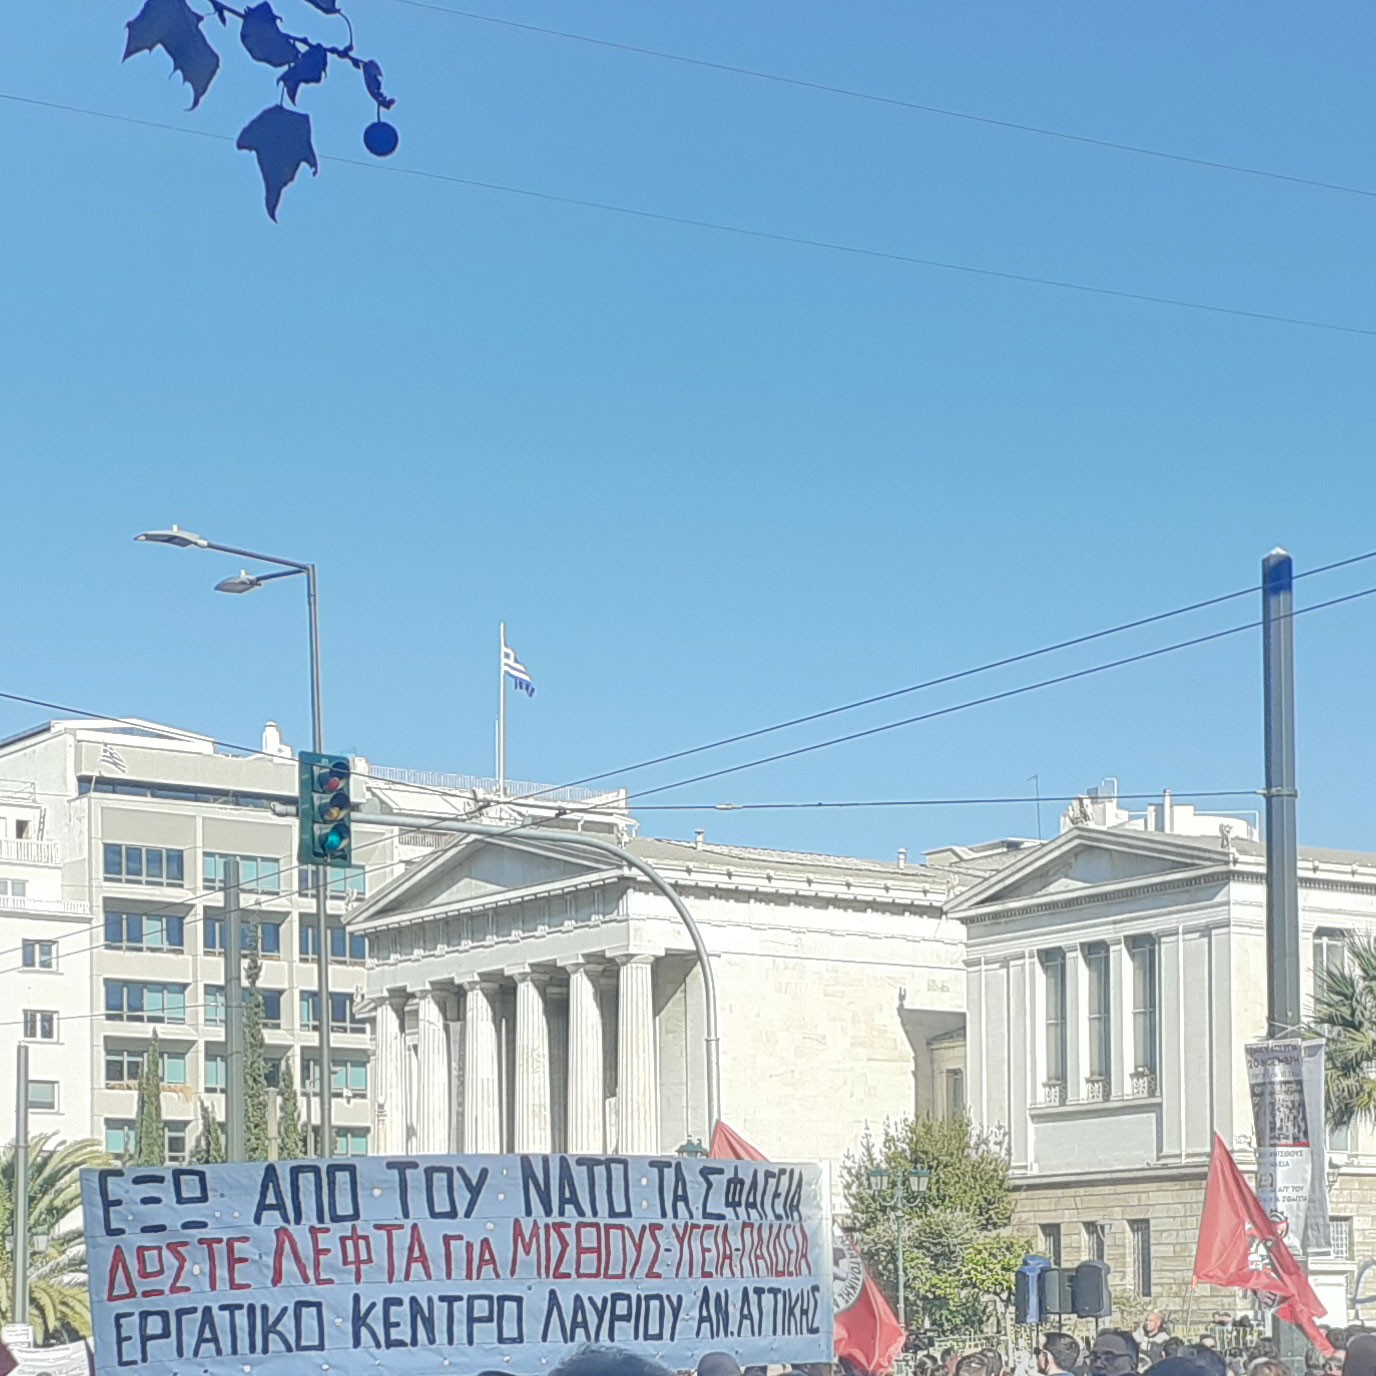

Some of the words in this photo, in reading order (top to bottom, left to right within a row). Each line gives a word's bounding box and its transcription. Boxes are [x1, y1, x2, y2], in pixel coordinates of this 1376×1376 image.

[99, 1168, 209, 1236] ΕΞΩ
[253, 1163, 361, 1226] ΑΠΟ
[385, 1161, 487, 1220] ΤΟΥ
[520, 1155, 633, 1219] ΝΑΤΟ
[648, 1160, 694, 1220] ΤΑ
[699, 1165, 804, 1222] ΣΦΑΓΕΙΑ
[107, 1236, 252, 1302] ΔΩΣΤΕ
[271, 1222, 432, 1288] ΛΕΦΤΑ
[442, 1233, 500, 1281] ΓΙΑ
[114, 1300, 325, 1367] ΕΡΓΑΤΙΚΟ
[352, 1293, 524, 1350] ΚΕΝΤΡΟ
[542, 1288, 683, 1344] ΛΑΥΡΙΟΥ
